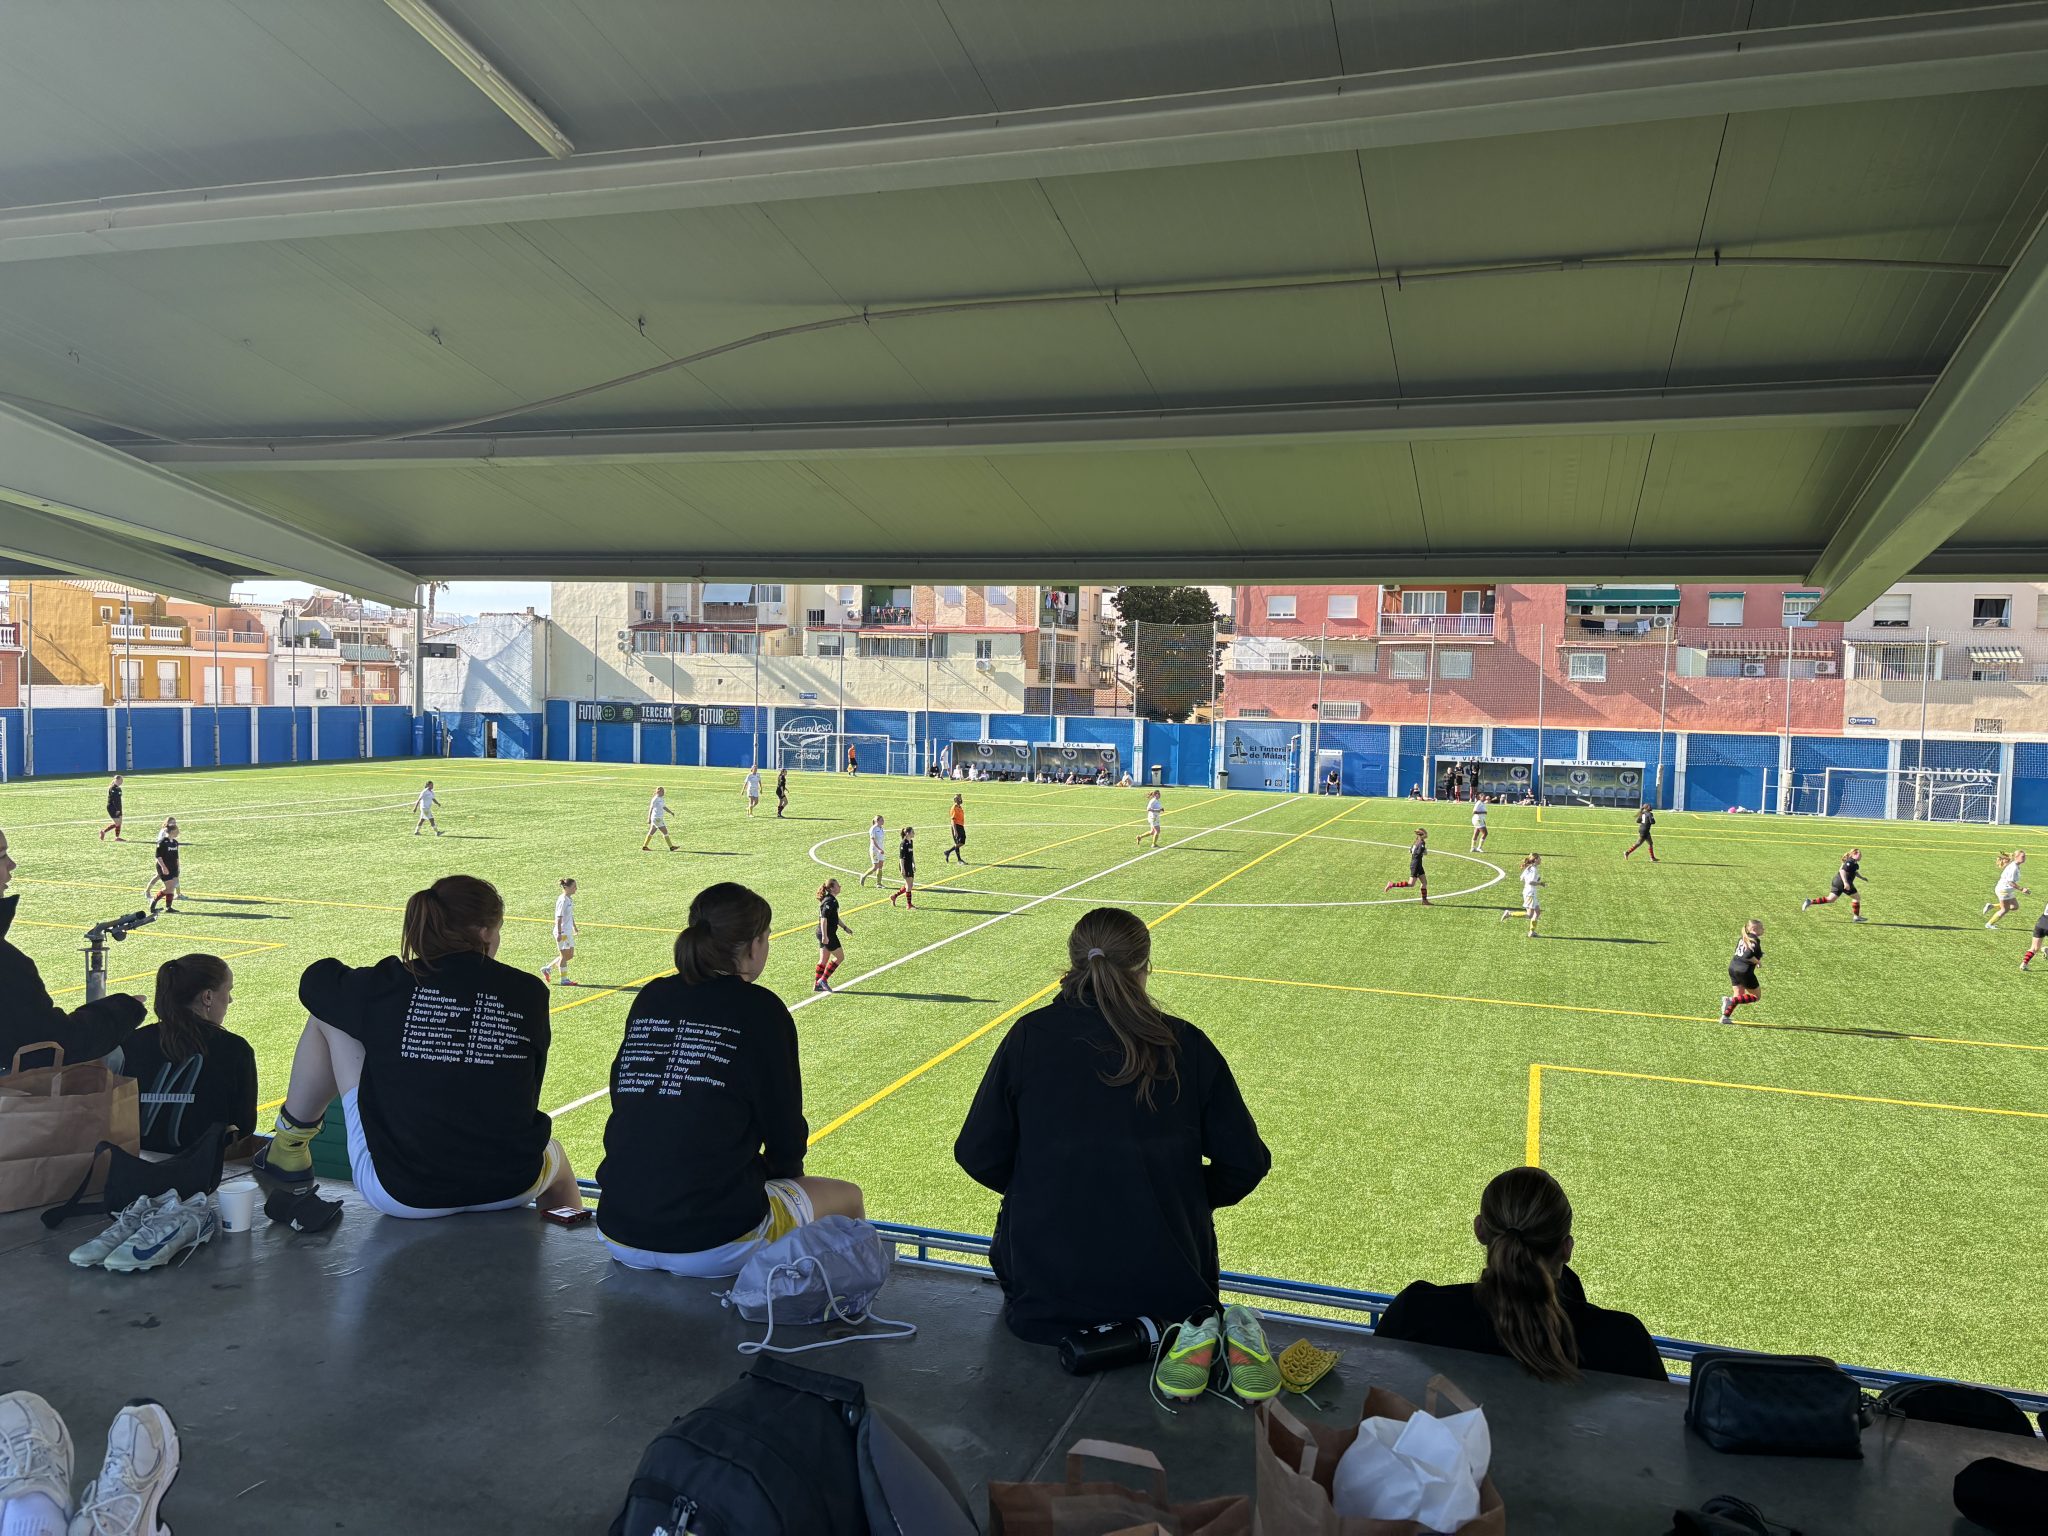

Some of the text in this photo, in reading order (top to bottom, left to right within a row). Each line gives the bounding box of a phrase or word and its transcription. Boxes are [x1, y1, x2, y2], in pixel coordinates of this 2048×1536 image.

[641, 706, 672, 718] TERCERA
[1262, 752, 1287, 761] Málag
[1907, 767, 1994, 783] PRIMOR
[705, 1030, 721, 1038] baby
[681, 1043, 717, 1052] Slaapdienst
[421, 1054, 460, 1062] Klapwijkjes
[685, 1075, 726, 1088] Houwelingen
